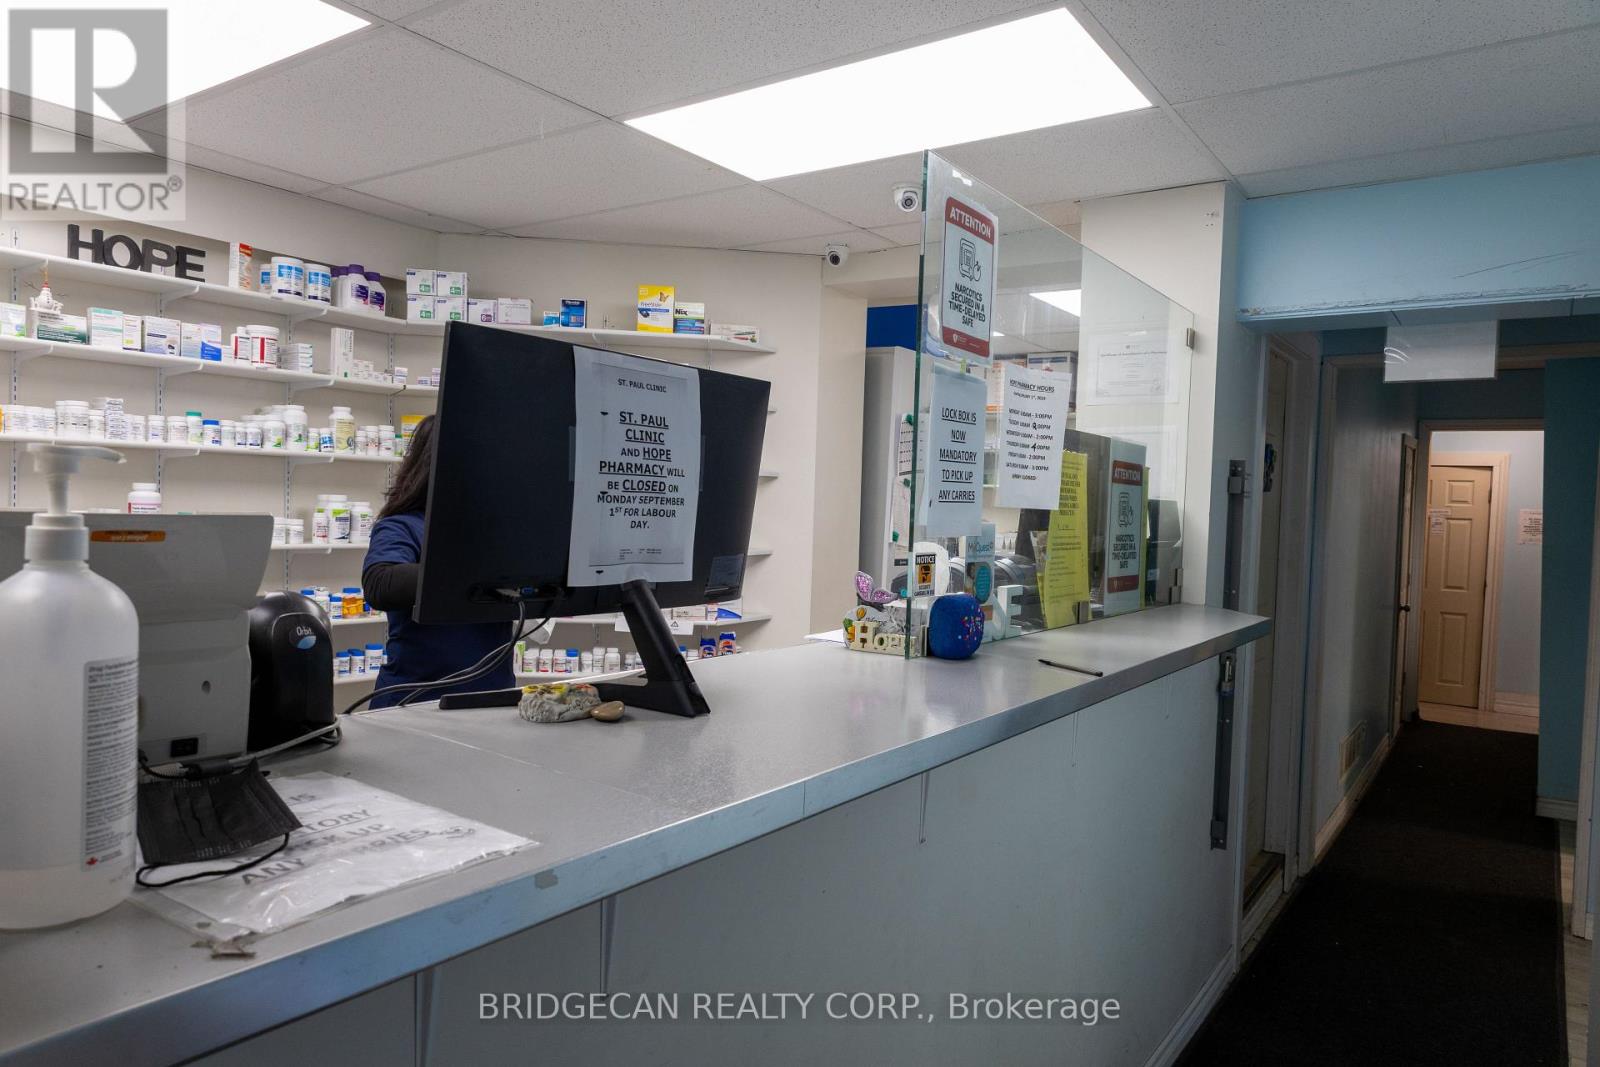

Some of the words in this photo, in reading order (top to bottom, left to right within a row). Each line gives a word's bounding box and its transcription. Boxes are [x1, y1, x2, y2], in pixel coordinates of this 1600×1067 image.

[950, 206, 991, 239] ATTENTION
[67, 224, 206, 282] HOPE
[955, 282, 982, 302] NARCOTICS
[951, 291, 974, 308] SECURED
[975, 301, 981, 311] IN
[981, 304, 985, 313] A
[675, 308, 688, 316] Nix
[948, 300, 986, 322] TIME-DELAYED
[962, 315, 974, 328] SAFE
[617, 378, 628, 387] ST.
[629, 381, 645, 390] PAUL
[646, 384, 667, 393] CLINIC
[619, 411, 637, 423] ST.
[641, 413, 669, 428] PAUL
[942, 407, 957, 419] LOCK
[958, 410, 970, 421] BOX
[971, 412, 977, 423] IS
[625, 428, 665, 444] CLINIC
[951, 430, 966, 441] NOW
[621, 447, 640, 457] AND
[643, 446, 672, 461] HOPE
[940, 448, 977, 462] MANDATORY
[599, 460, 665, 477] PHARMACY
[667, 467, 685, 477] WILL
[942, 469, 950, 480] TO
[951, 470, 964, 480] PICK
[965, 471, 973, 480] UP
[607, 481, 619, 491] BE
[622, 479, 667, 493] CLOSED
[668, 484, 679, 493] ON
[597, 493, 637, 504] MONDAY
[638, 496, 685, 506] SEPTEMBER
[939, 489, 951, 500] ANY
[951, 490, 975, 501] CARRIES
[624, 508, 639, 517] FOR
[641, 508, 676, 518] LABOUR
[630, 520, 650, 529] DAY.
[916, 555, 935, 564] NOTICE
[242, 858, 304, 885] ANY
